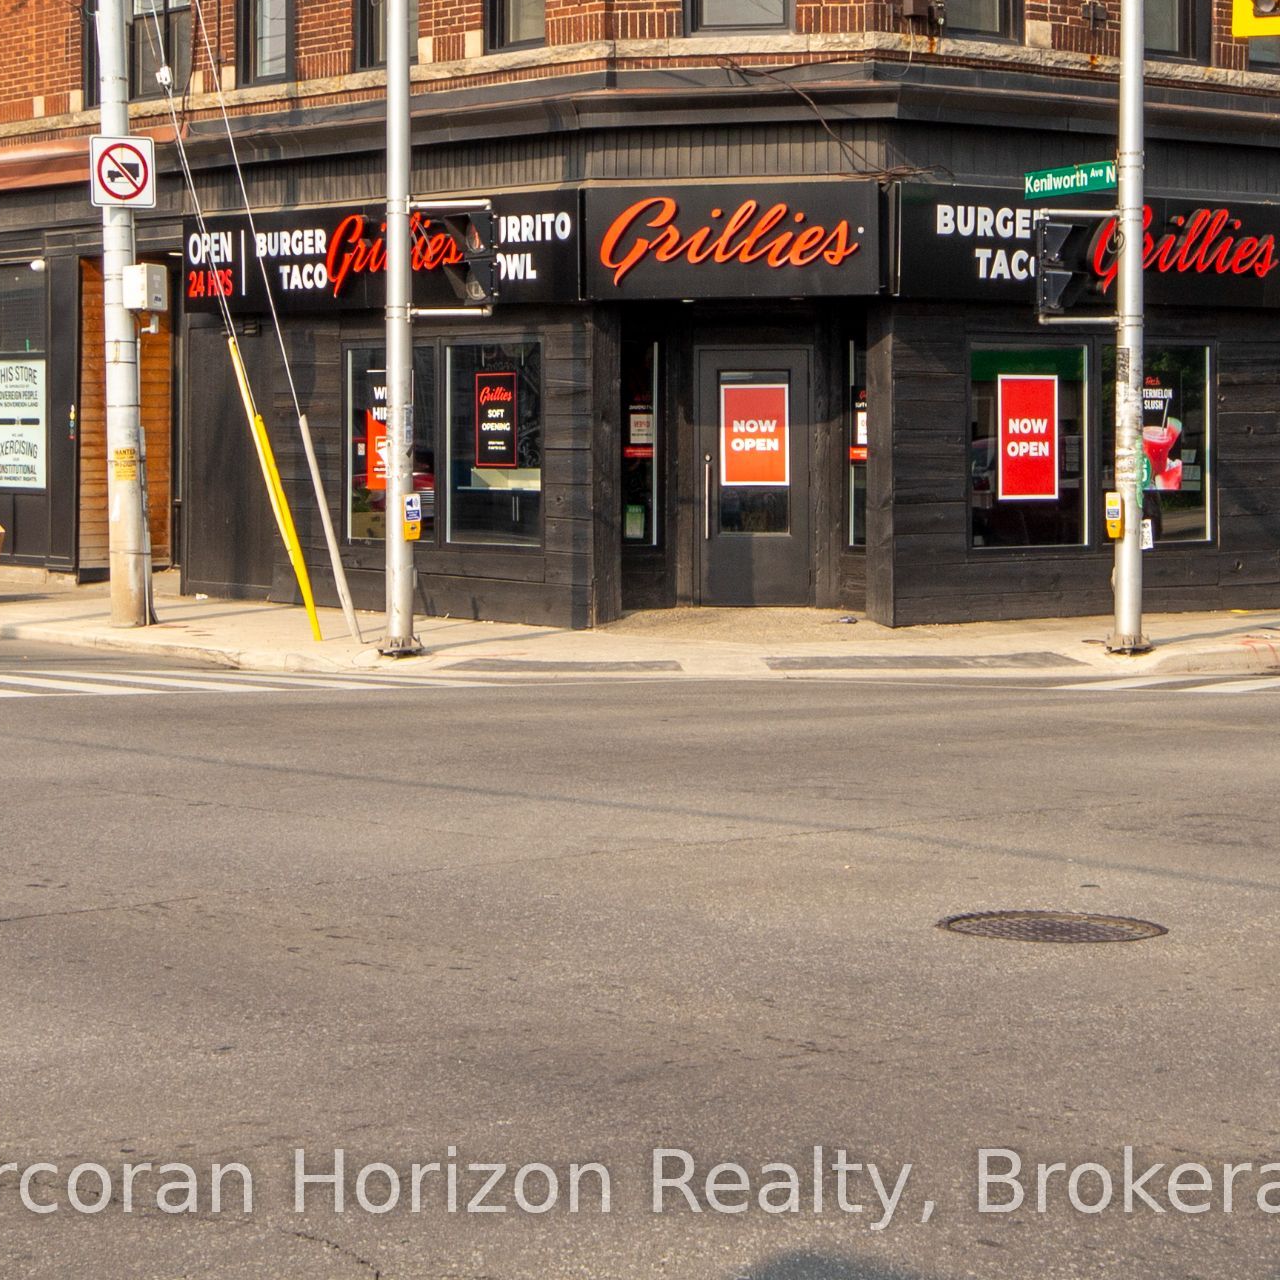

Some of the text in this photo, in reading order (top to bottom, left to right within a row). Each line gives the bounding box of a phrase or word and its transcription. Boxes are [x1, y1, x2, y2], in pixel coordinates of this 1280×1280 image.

[1025, 165, 1116, 194] Kenilworth Ave N
[188, 231, 232, 265] OPEN
[255, 228, 327, 258] BURGER
[599, 196, 859, 287] Grillies
[496, 253, 537, 280] OWL
[188, 269, 233, 297] 24 HRS
[279, 263, 328, 290] TACO
[15, 365, 38, 385] STORE
[22, 390, 38, 400] PEOPLE
[479, 386, 513, 406] Grillies
[1142, 388, 1173, 399] TERMELON
[487, 408, 505, 418] SOFT
[1144, 399, 1164, 410] SLUSH
[481, 422, 511, 431] OPENING
[732, 419, 778, 433] NOW
[1008, 418, 1048, 434] NOW
[731, 438, 779, 452] OPEN
[1007, 441, 1050, 457] OPEN
